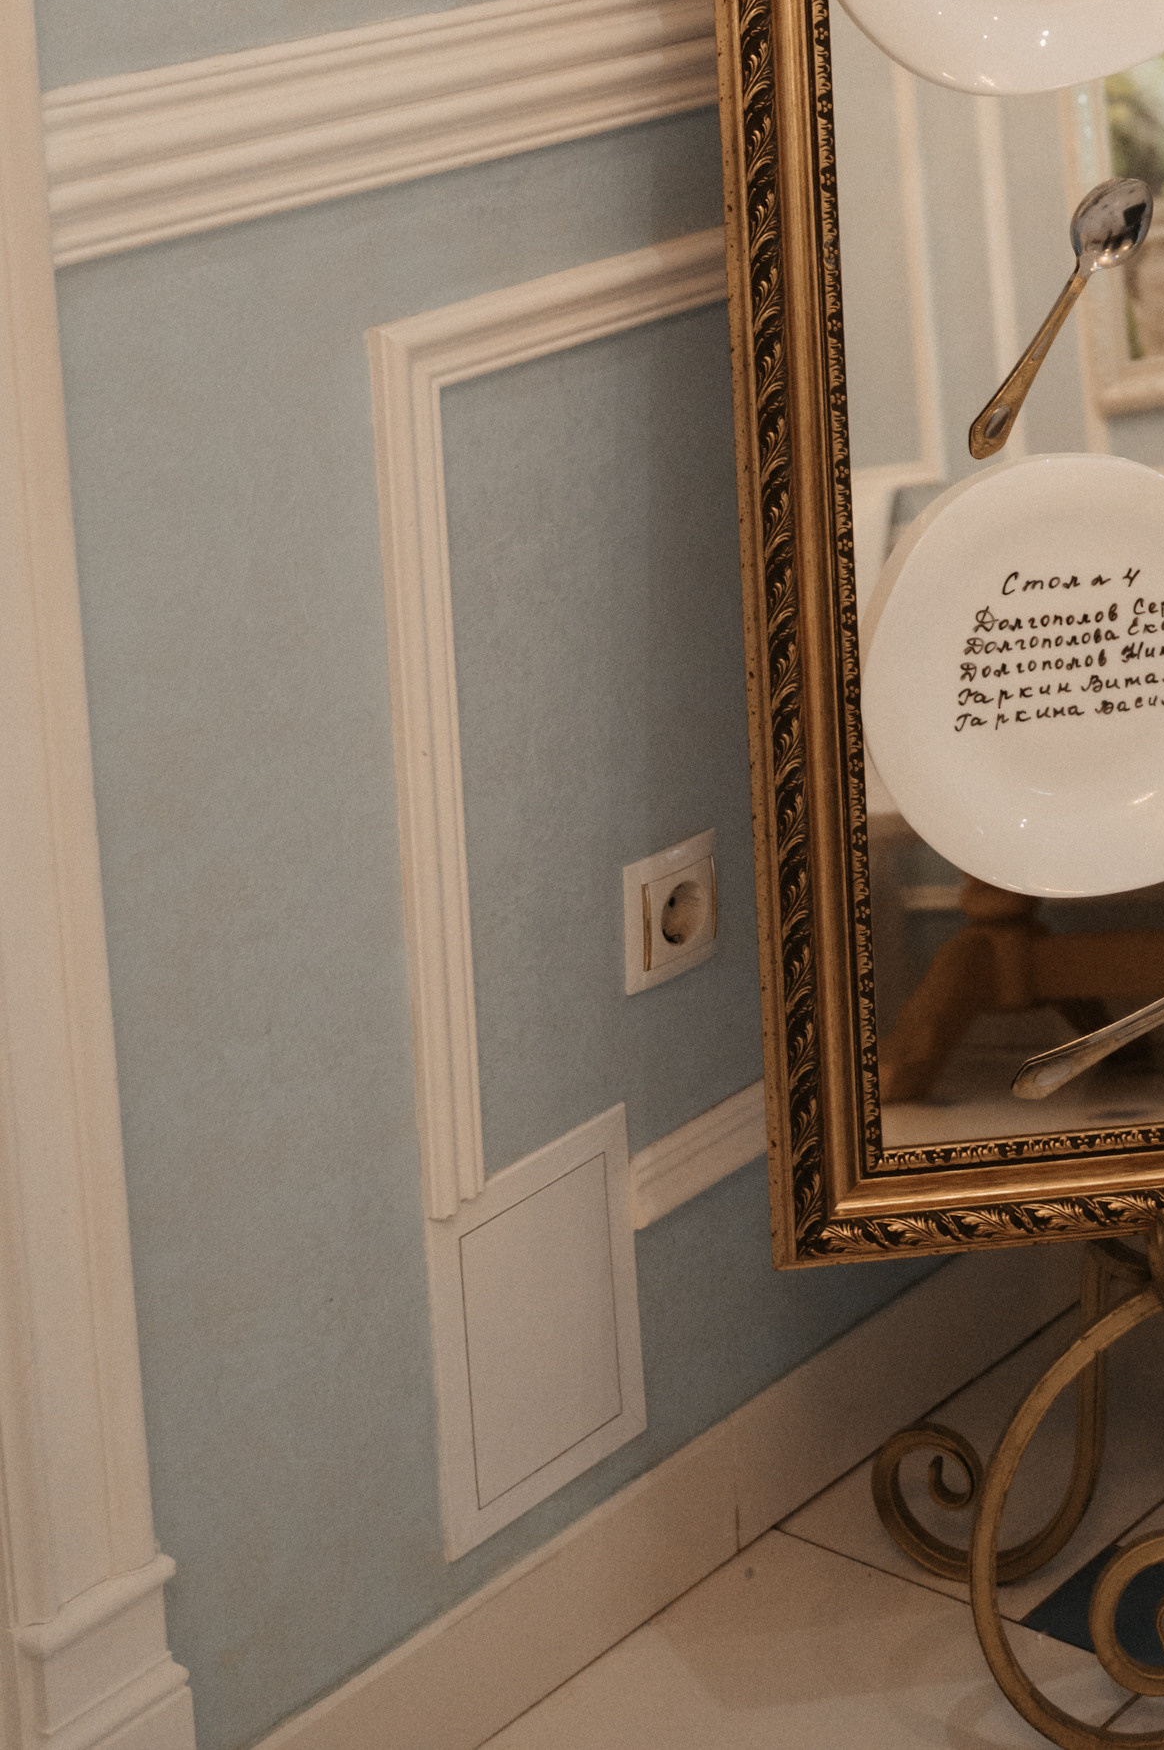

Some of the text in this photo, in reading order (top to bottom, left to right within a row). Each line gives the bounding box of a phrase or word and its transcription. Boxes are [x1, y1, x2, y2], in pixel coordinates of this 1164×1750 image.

[1002, 571, 1081, 596] Стол
[1122, 567, 1141, 588] 4
[973, 605, 1119, 633] Долгополов
[963, 629, 1119, 656] Долгополова
[960, 649, 1108, 682] Долгополов
[958, 680, 1072, 709] Гаркин
[954, 704, 1085, 732] Гаркина
